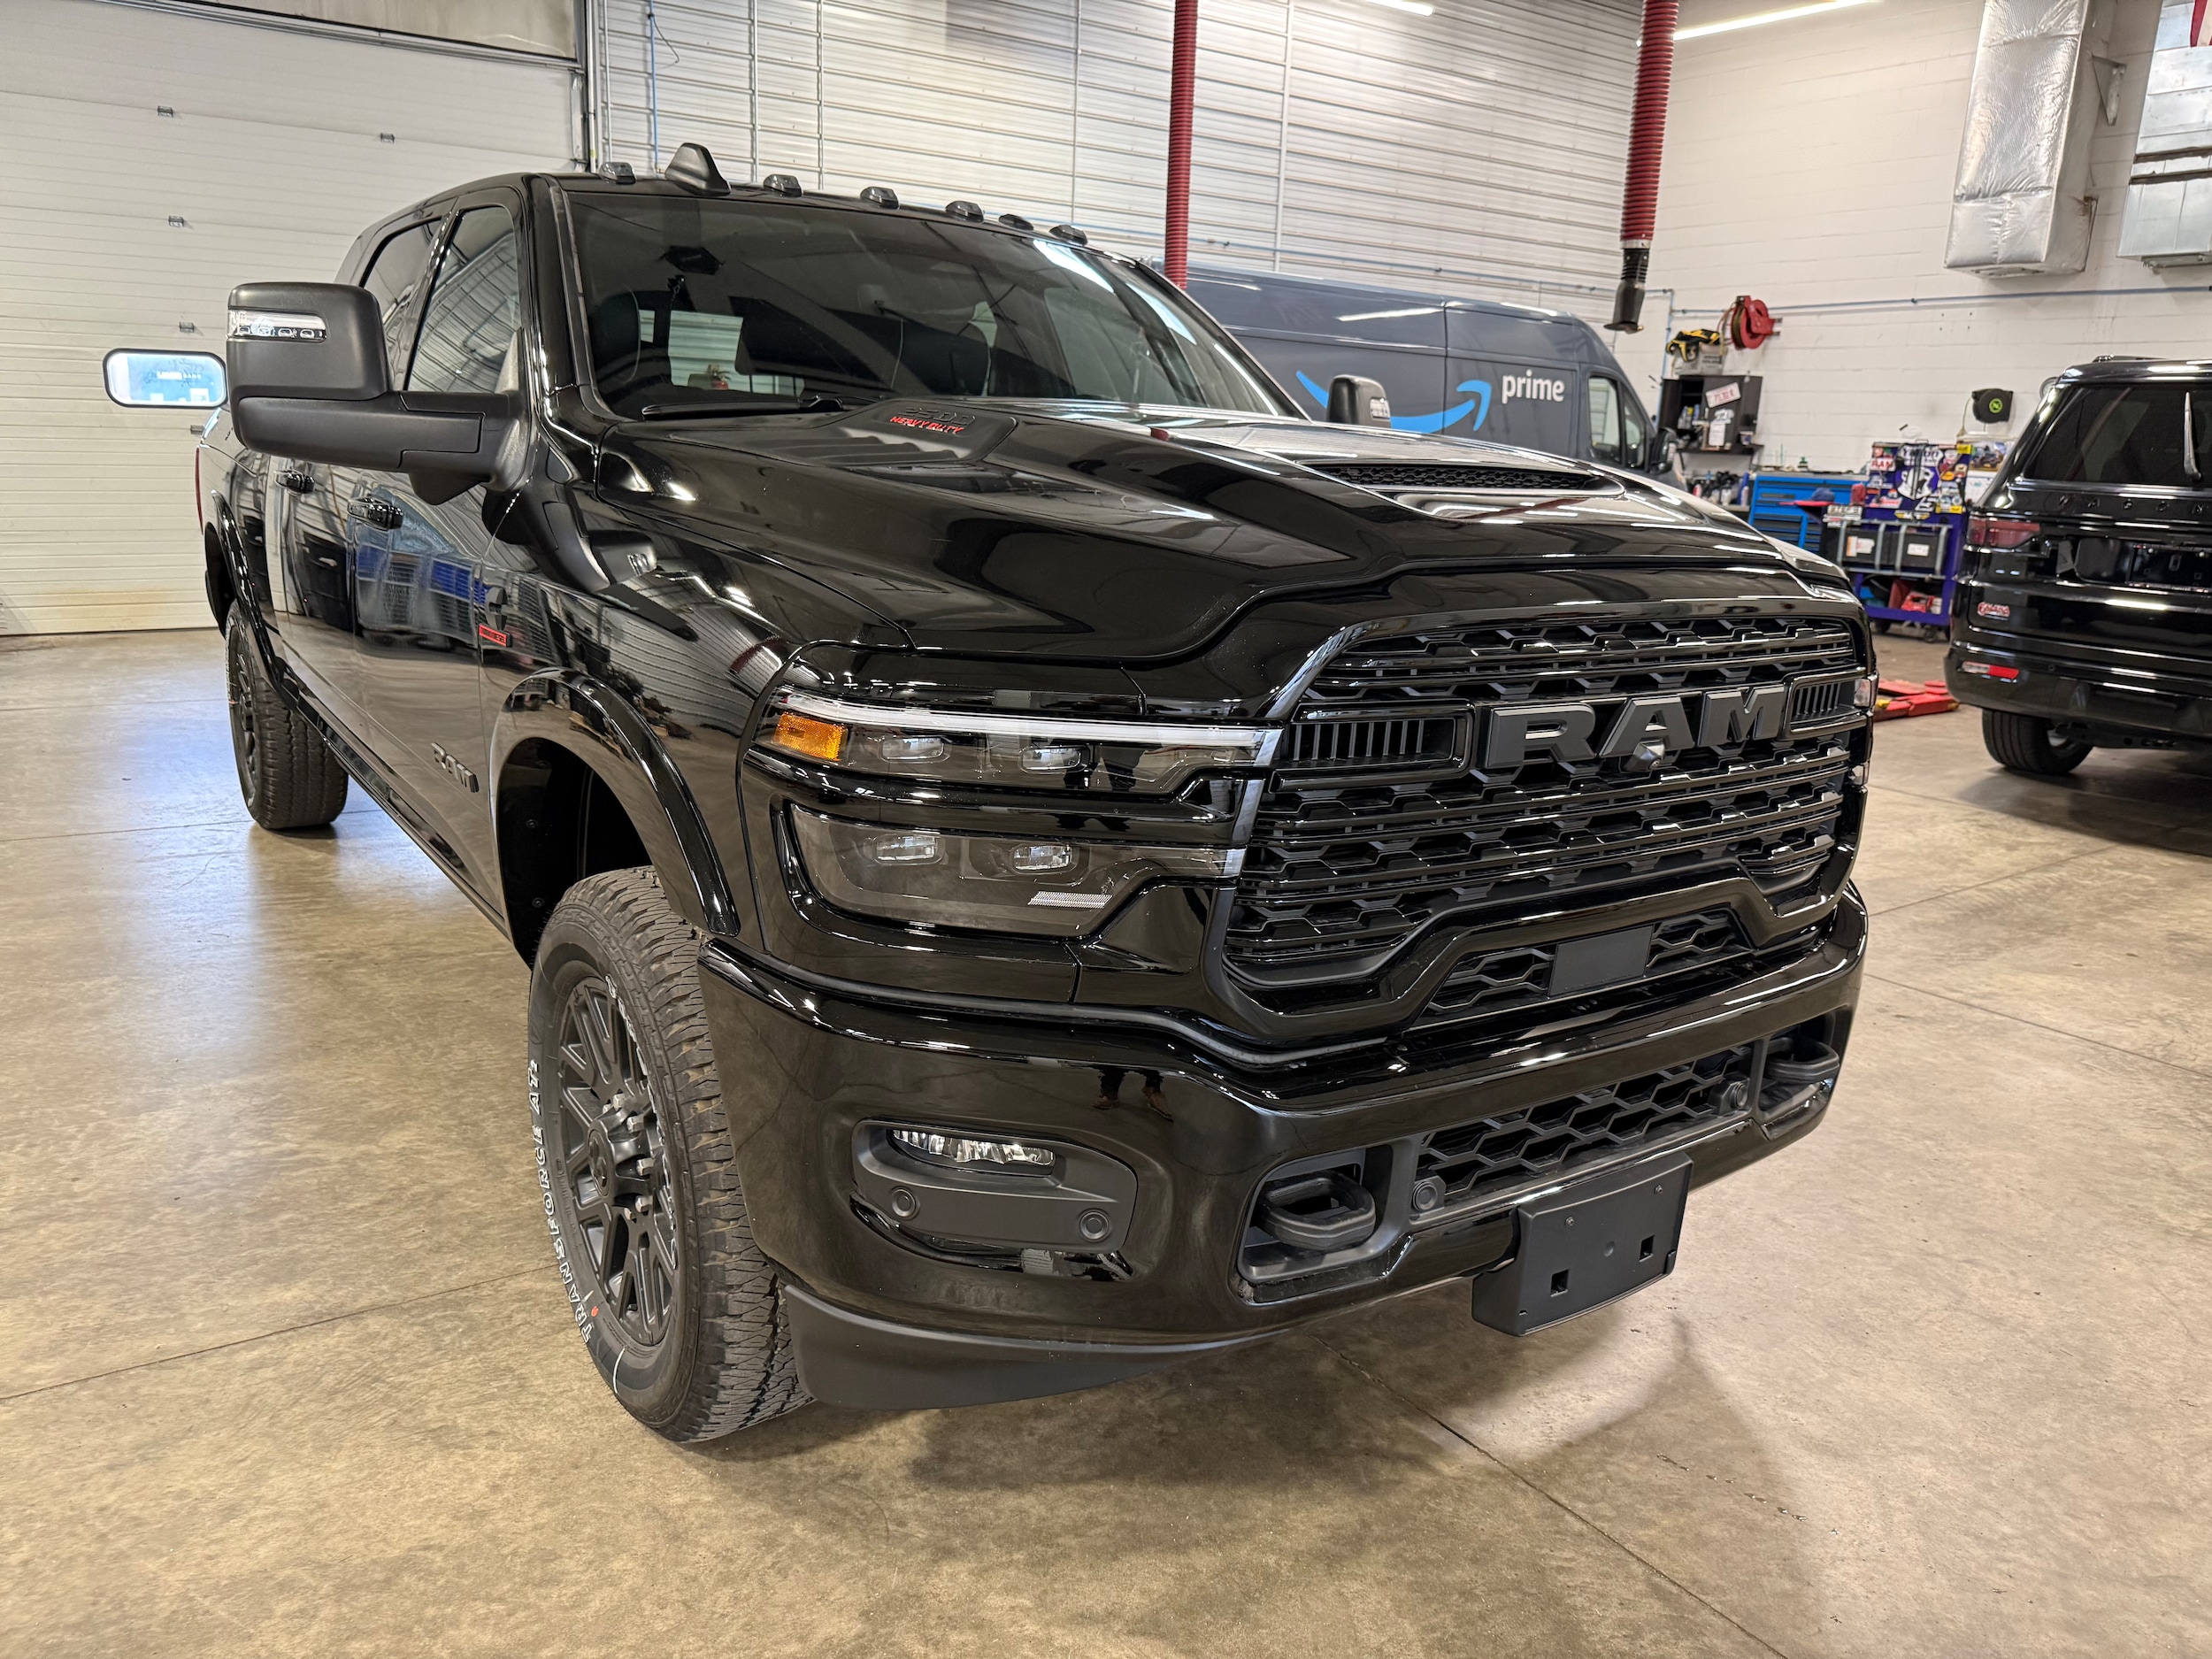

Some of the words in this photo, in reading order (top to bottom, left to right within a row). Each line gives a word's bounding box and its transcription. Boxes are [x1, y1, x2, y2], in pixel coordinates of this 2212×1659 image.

[1502, 369, 1564, 403] prime
[889, 416, 930, 428] HEAVY
[926, 422, 964, 434] DUTY
[896, 407, 976, 426] 2500
[1487, 684, 1785, 768] RAM
[431, 742, 480, 793] RAM
[533, 1124, 594, 1343] TRANSFORCE
